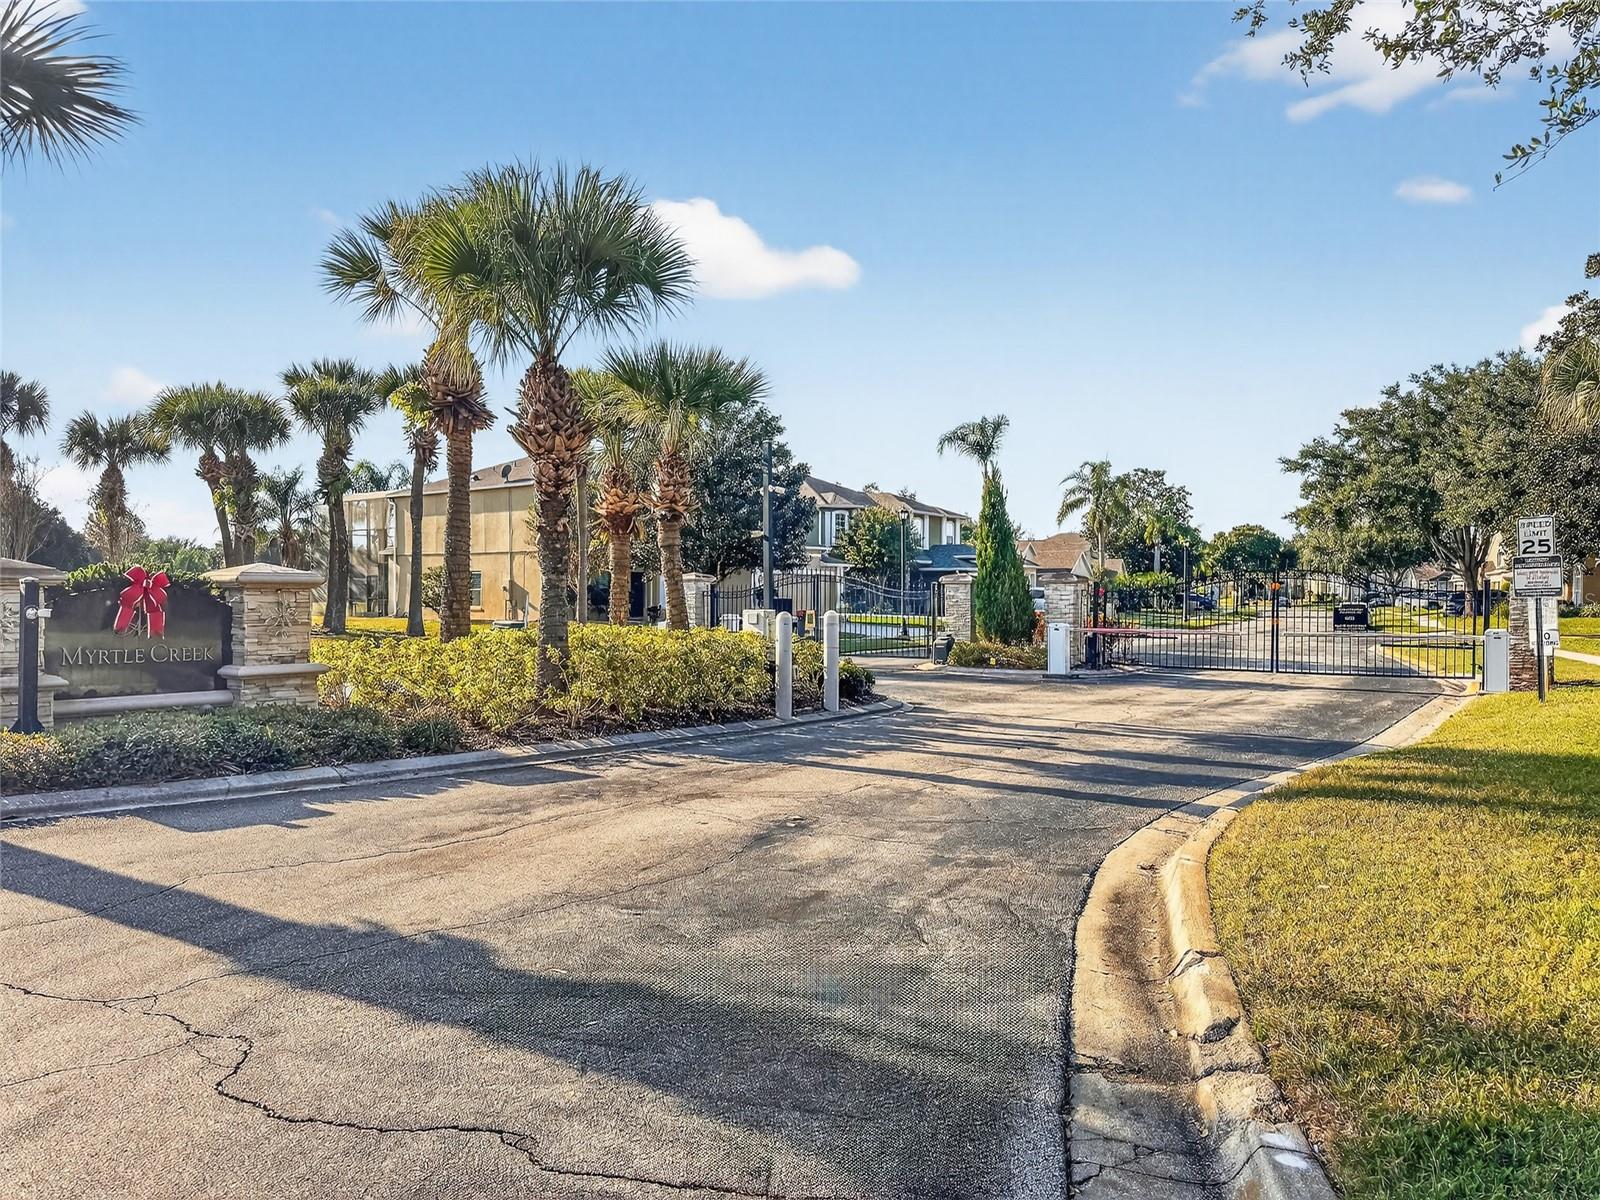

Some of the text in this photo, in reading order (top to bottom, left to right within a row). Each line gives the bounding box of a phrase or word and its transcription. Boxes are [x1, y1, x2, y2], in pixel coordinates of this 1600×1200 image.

[1520, 520, 1551, 530] SPEED
[1523, 529, 1547, 538] LIMIT
[1521, 538, 1551, 554] 25
[61, 643, 215, 666] MYRTLE CREEK
